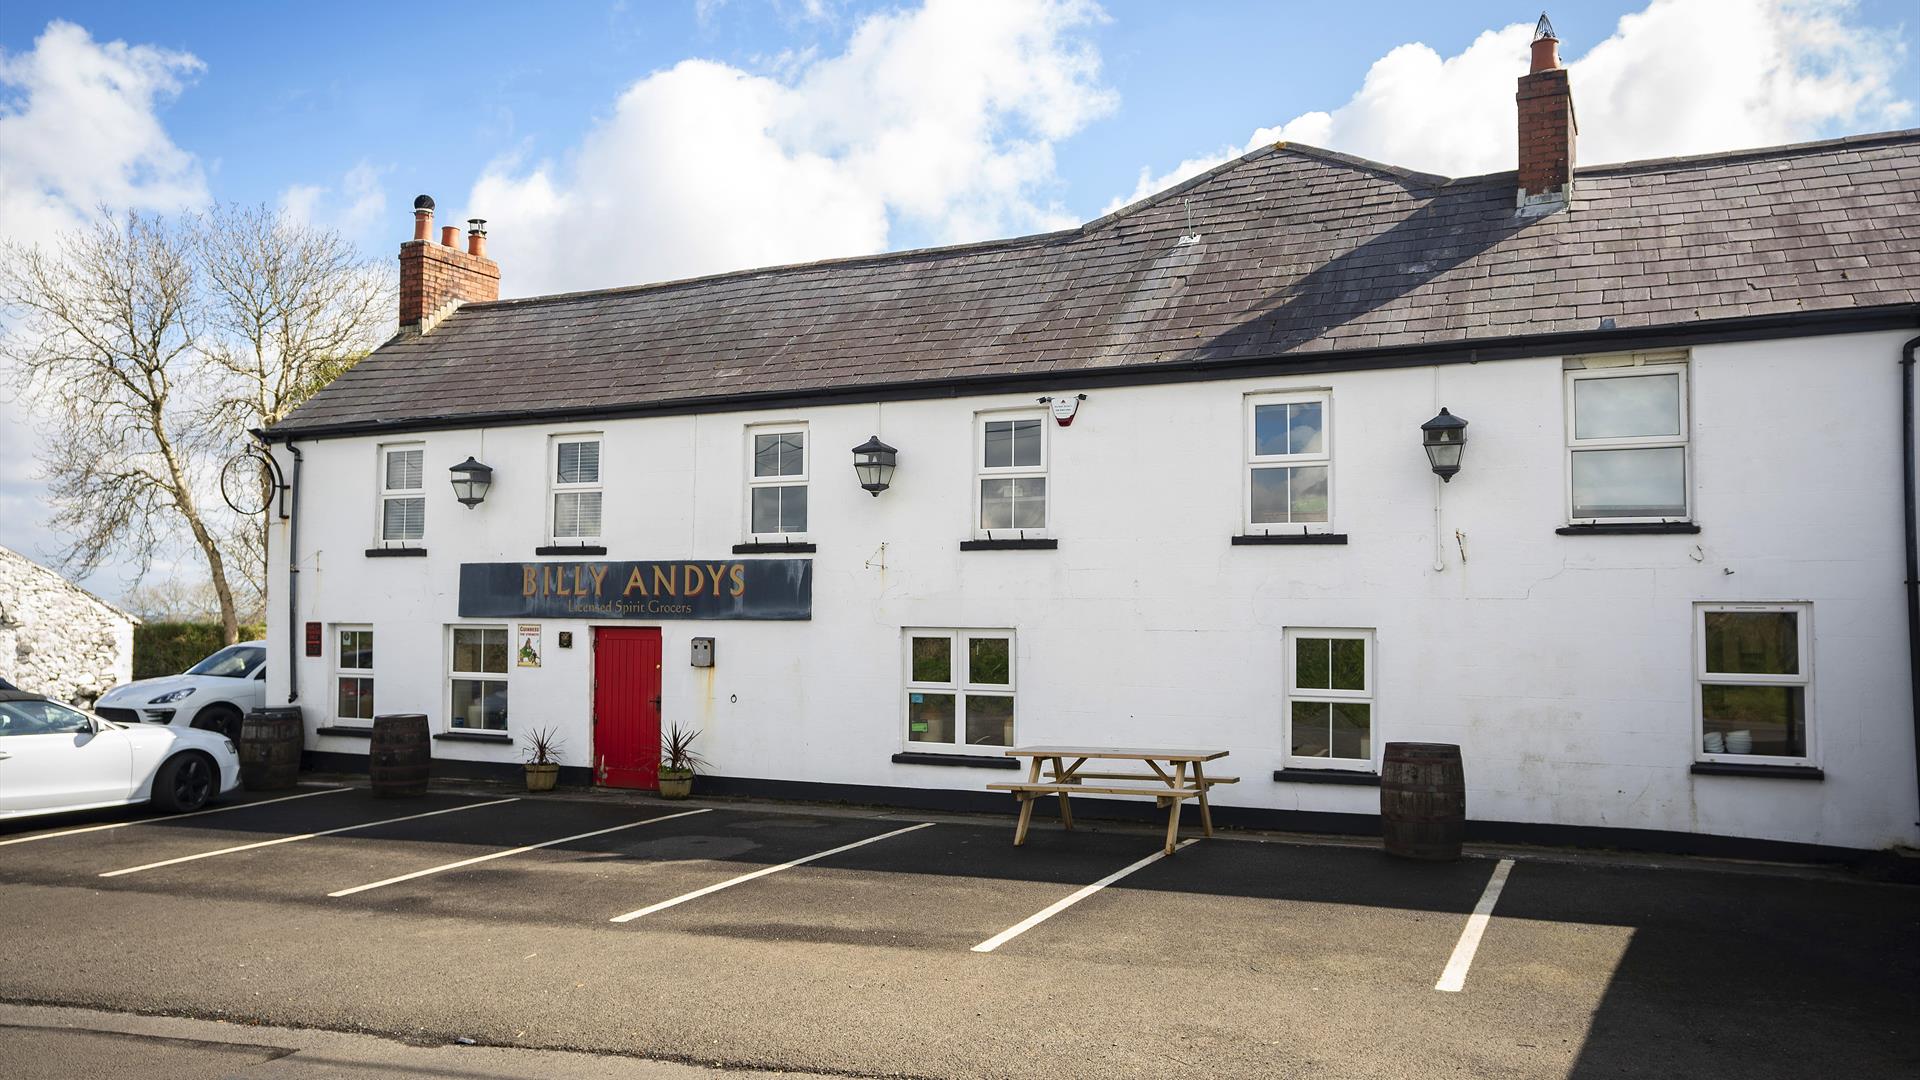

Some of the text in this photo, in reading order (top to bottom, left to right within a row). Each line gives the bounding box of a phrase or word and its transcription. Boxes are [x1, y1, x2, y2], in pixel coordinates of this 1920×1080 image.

[522, 564, 745, 597] BILLY ANDYS
[615, 600, 646, 615] Spirit
[648, 599, 692, 613] Grocers
